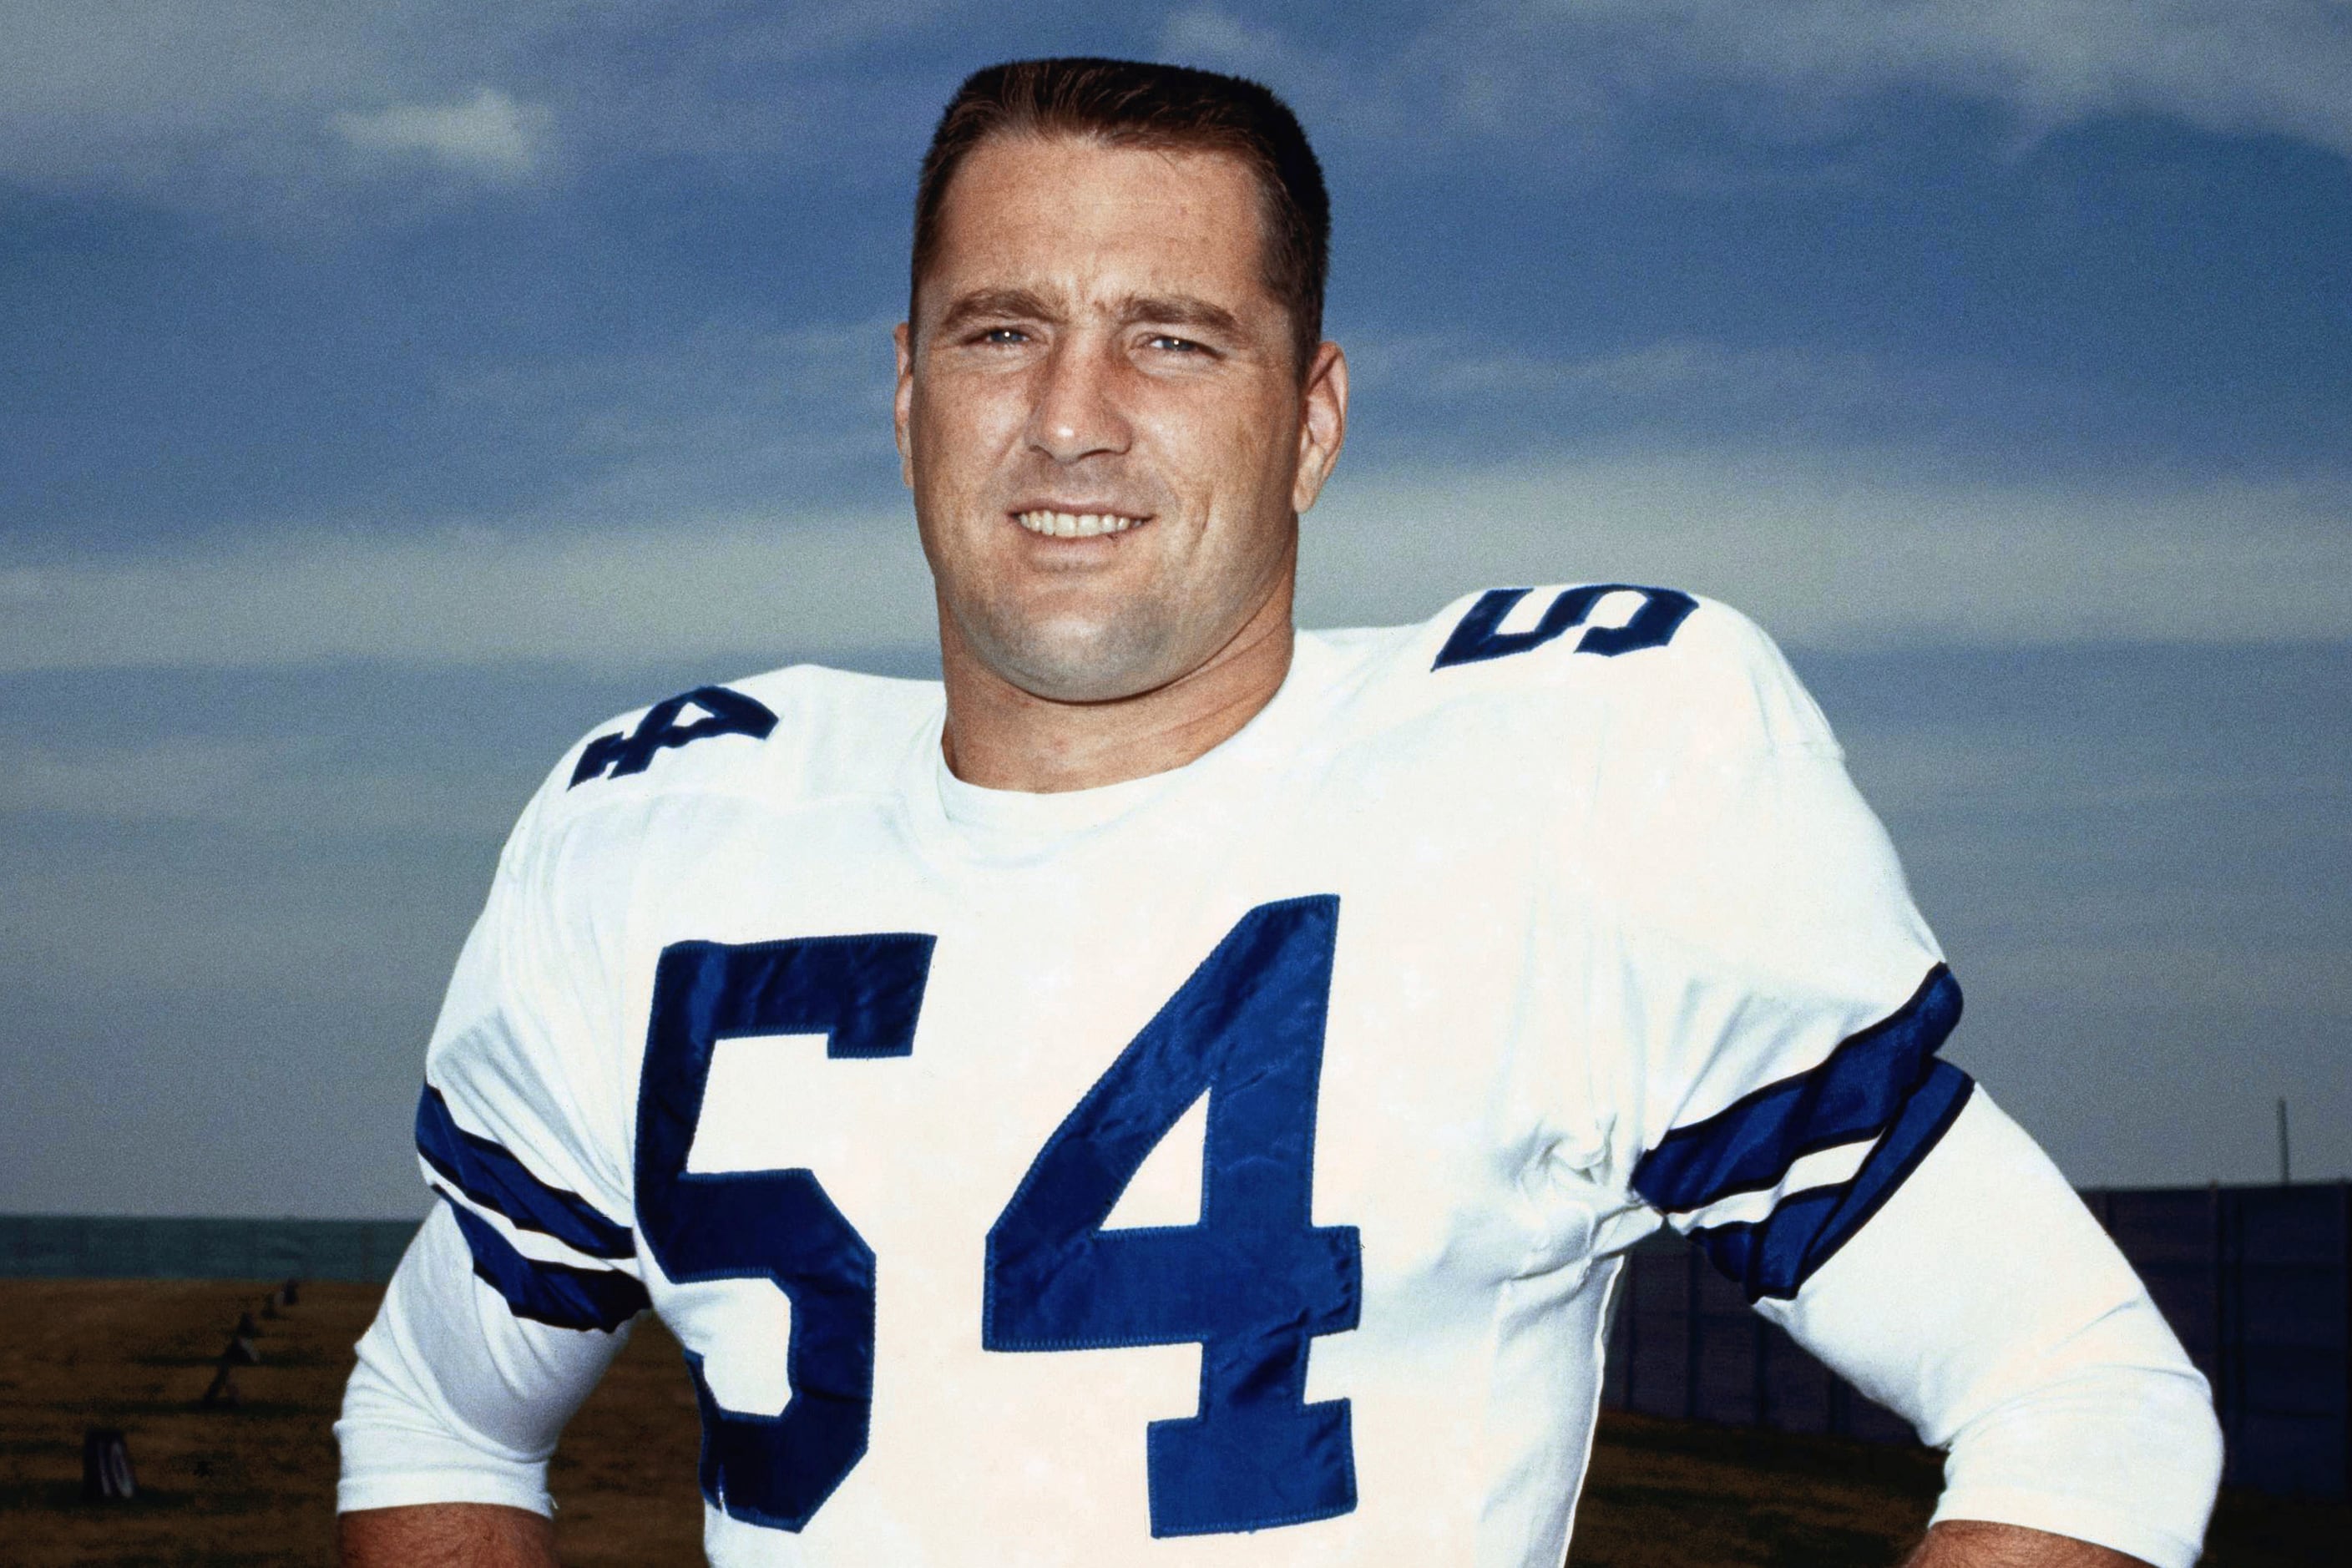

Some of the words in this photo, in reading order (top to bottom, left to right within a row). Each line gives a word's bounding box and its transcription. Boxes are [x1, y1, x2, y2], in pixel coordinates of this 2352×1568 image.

[1430, 583, 1699, 672] 5
[566, 685, 779, 792] 4
[635, 893, 1362, 1539] 54
